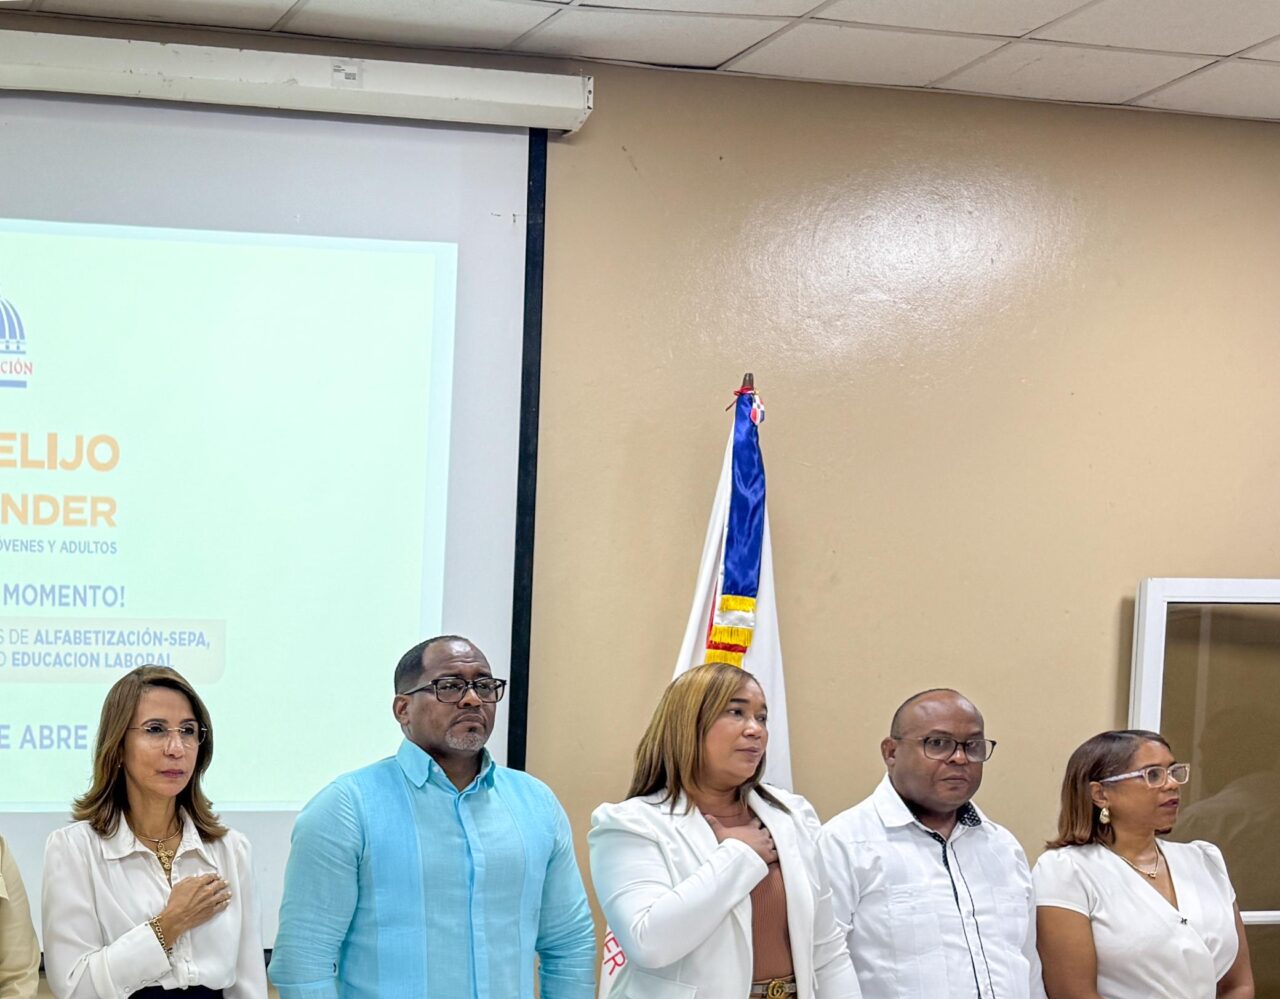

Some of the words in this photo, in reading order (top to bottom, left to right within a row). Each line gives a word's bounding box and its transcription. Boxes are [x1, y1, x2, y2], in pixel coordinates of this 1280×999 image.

[48, 540, 57, 553] Y
[59, 540, 118, 554] ADULTOS
[3, 583, 125, 608] MOMENTO!
[9, 629, 29, 645] DE
[33, 628, 211, 650] ALFABETIZACIÓN-SEPA,
[11, 651, 100, 667] EDUCACION
[19, 724, 88, 750] ABRE
